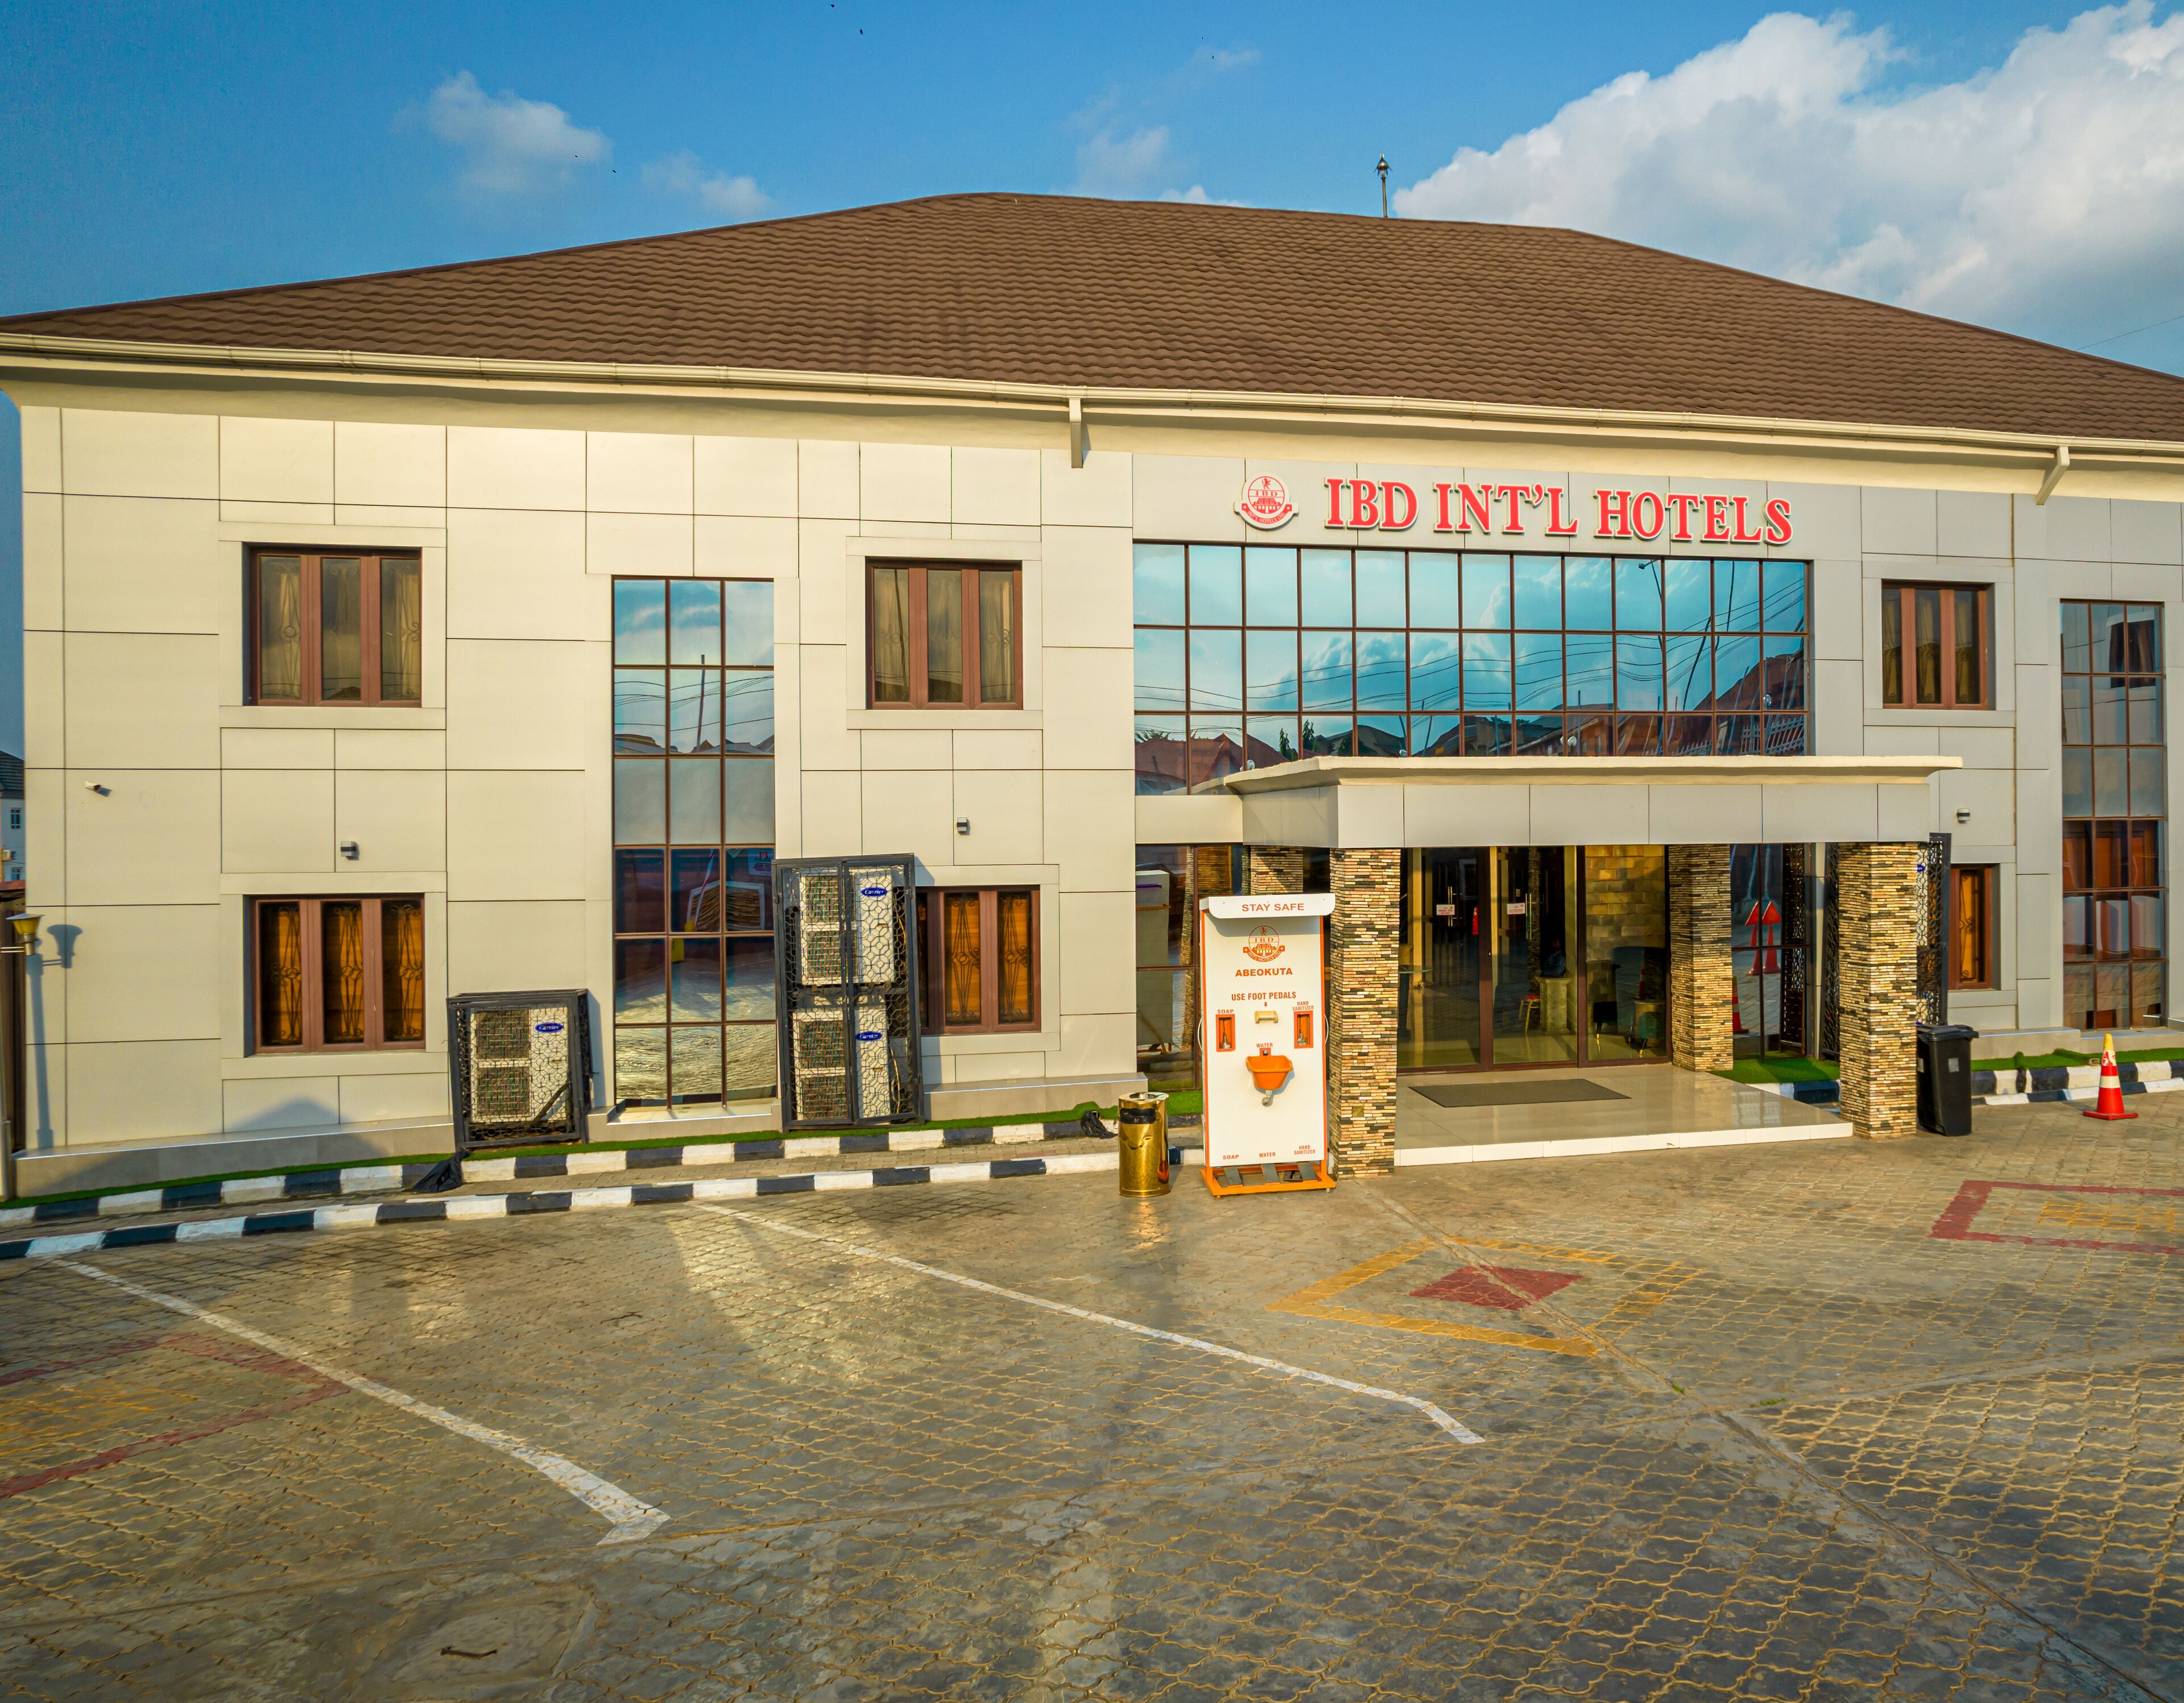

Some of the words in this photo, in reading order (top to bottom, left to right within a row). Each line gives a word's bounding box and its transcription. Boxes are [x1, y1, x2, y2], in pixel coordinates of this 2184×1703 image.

[1325, 478, 1419, 530] IBD
[1433, 482, 1579, 536] INT'L
[1595, 489, 1793, 544] HOTELS
[1235, 967, 1293, 977] ABEOKUTA
[1269, 991, 1296, 1000] PEDALS
